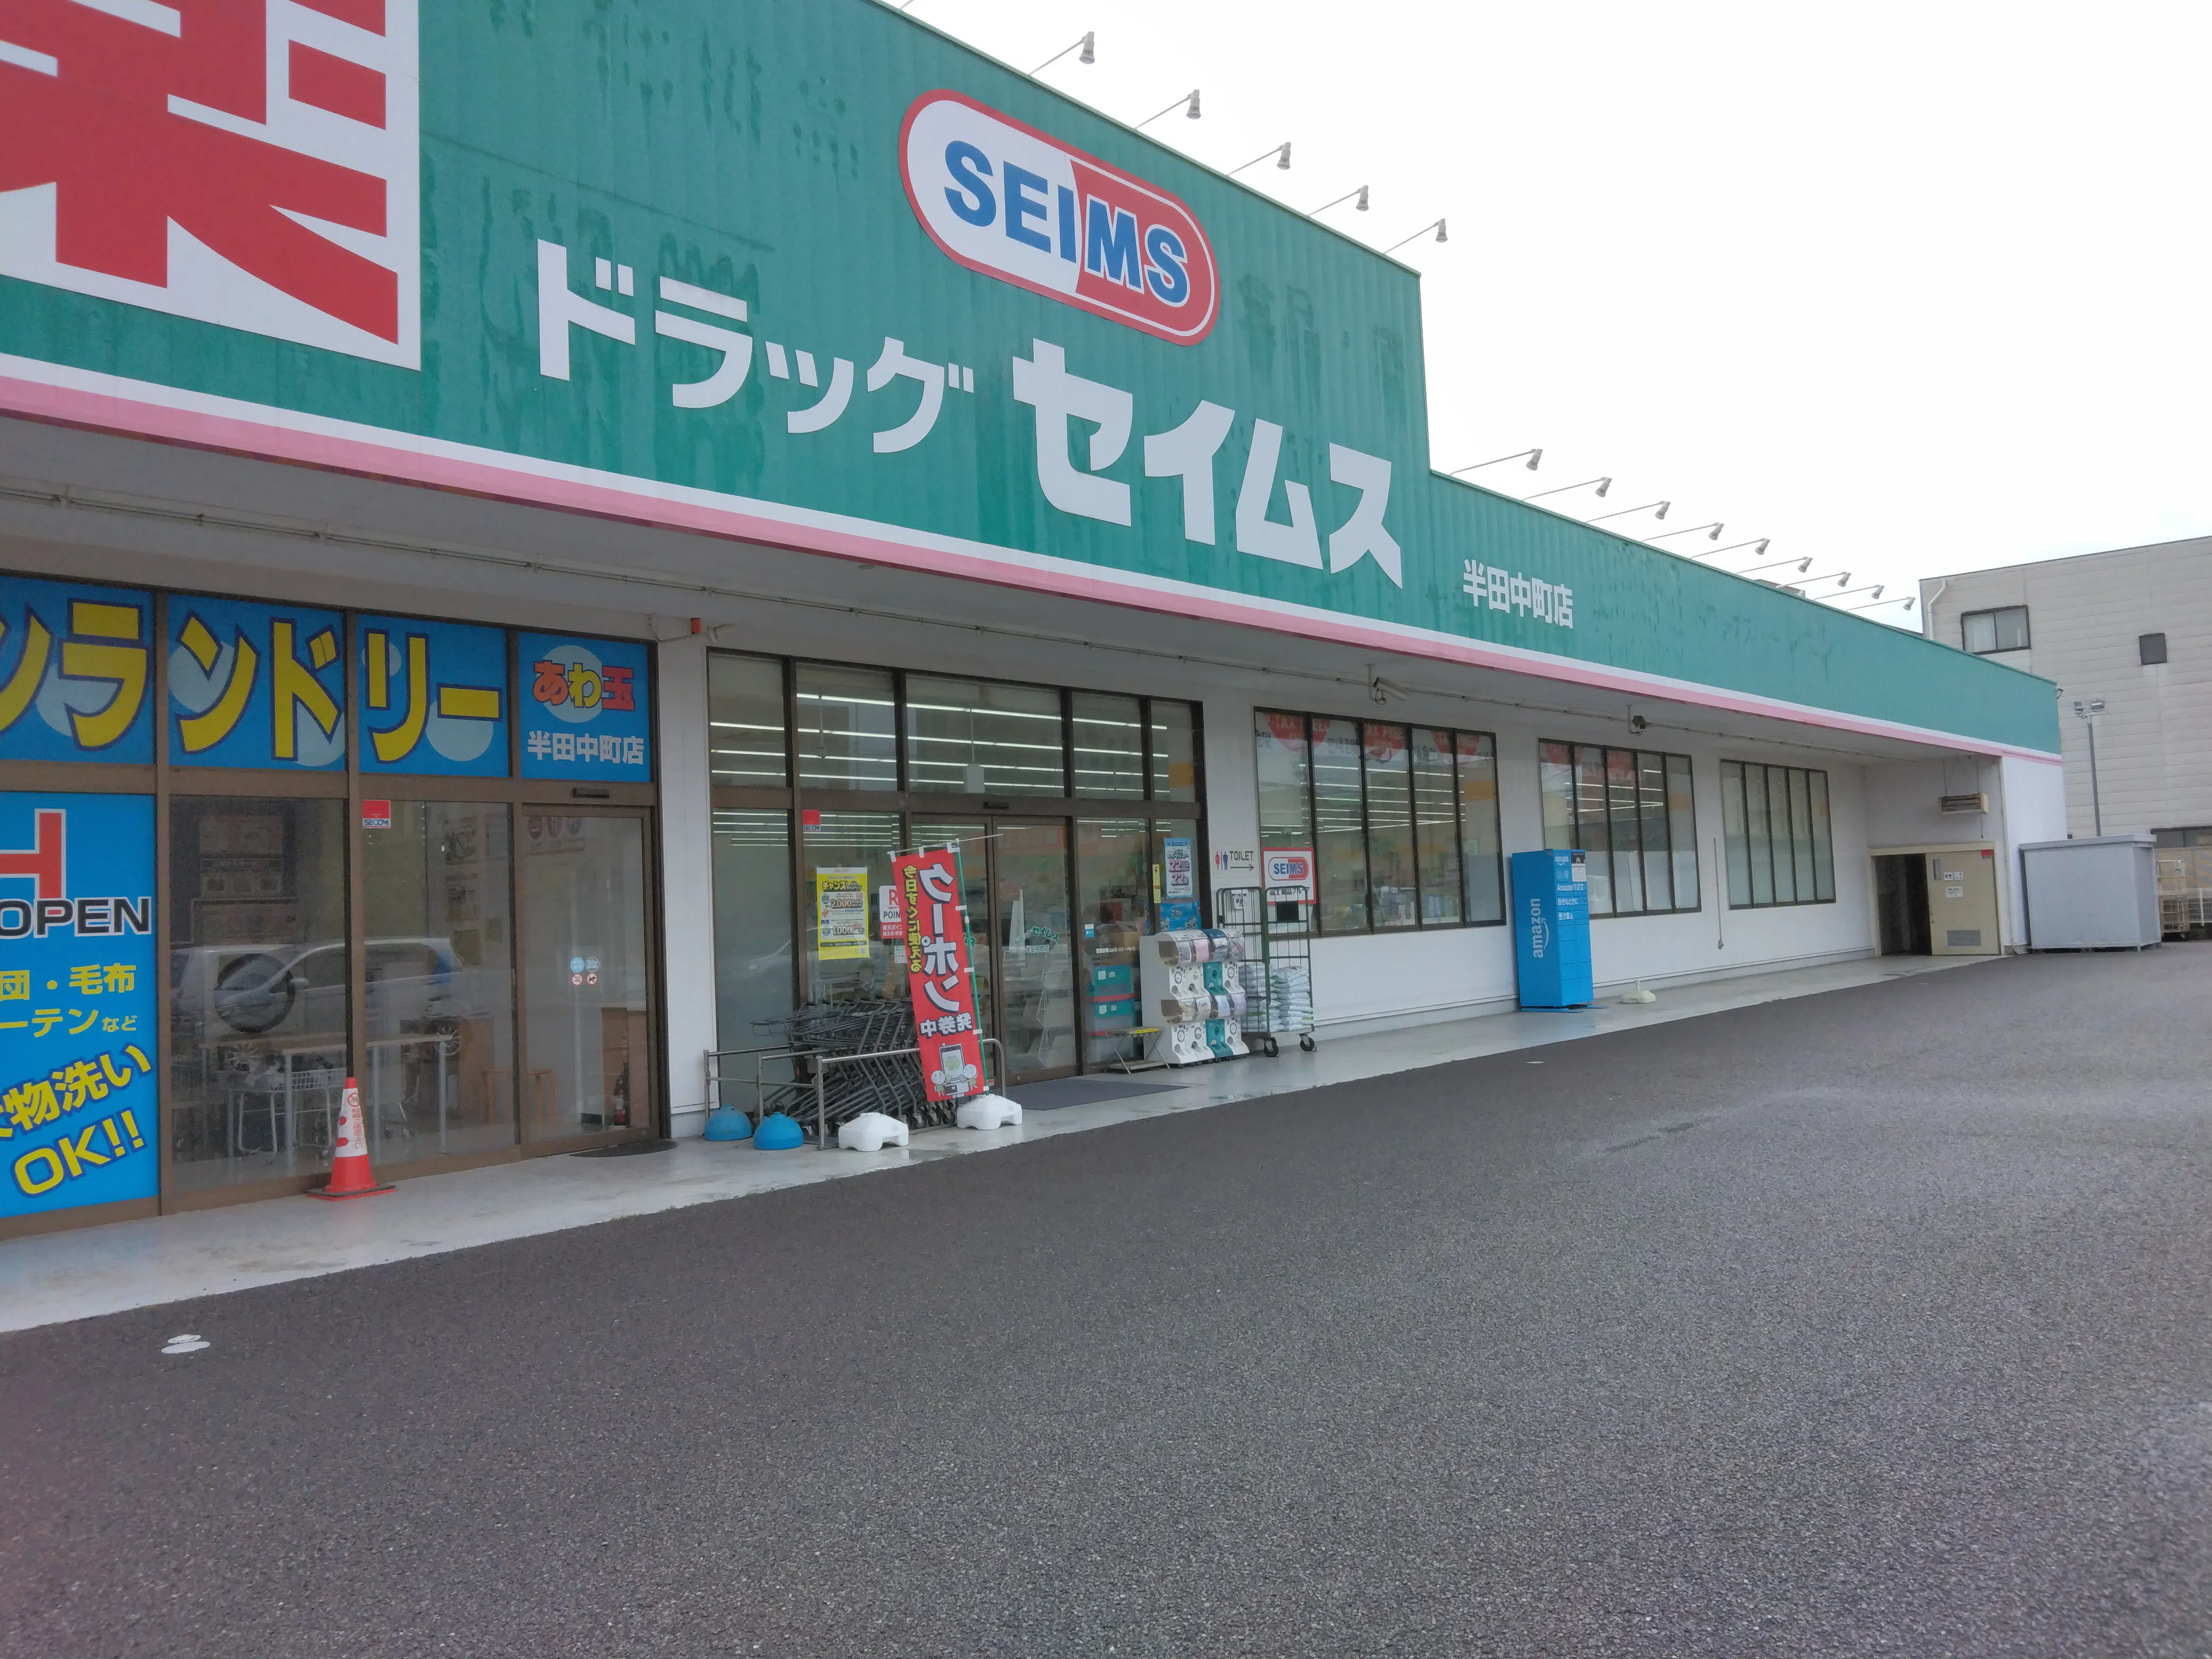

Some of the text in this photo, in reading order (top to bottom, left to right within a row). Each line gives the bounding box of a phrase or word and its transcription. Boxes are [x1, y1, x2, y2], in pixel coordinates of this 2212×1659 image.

[944, 140, 1190, 307] SEIMS
[1463, 558, 1573, 629] 半田中町店
[533, 660, 636, 711] あわ玉
[527, 730, 644, 766] 半田中町店
[1229, 851, 1254, 861] TOILET
[1273, 862, 1304, 875] SEIMS
[0, 896, 152, 938] OPEN
[1529, 898, 1544, 959] amazon
[0, 1044, 152, 1138] 物洗い
[14, 1109, 146, 1196] OK!!
